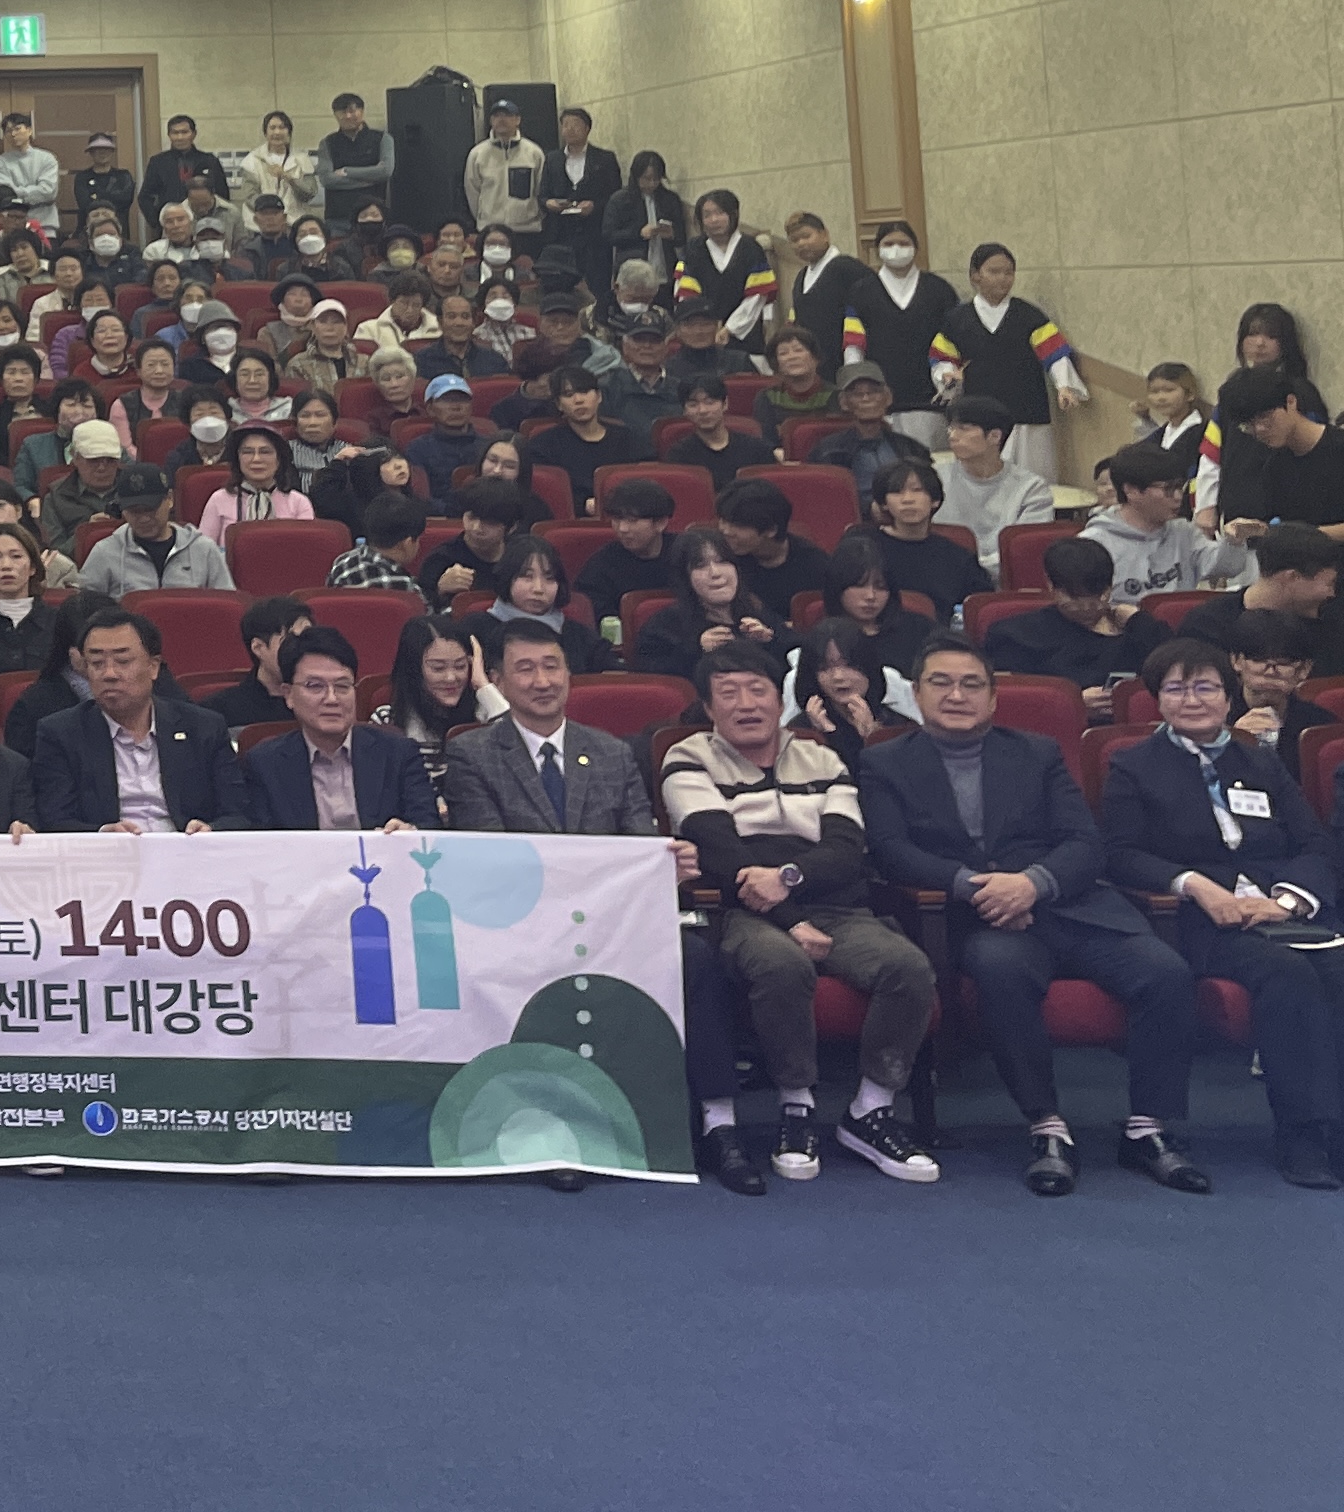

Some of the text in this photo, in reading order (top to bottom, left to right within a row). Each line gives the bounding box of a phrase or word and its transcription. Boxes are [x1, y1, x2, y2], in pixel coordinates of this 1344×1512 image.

[55, 898, 251, 957] 14:00
[104, 979, 259, 1036] 대강당
[121, 1108, 229, 1126] 한국가스공사
[234, 1109, 353, 1132] 당진기지건설단
